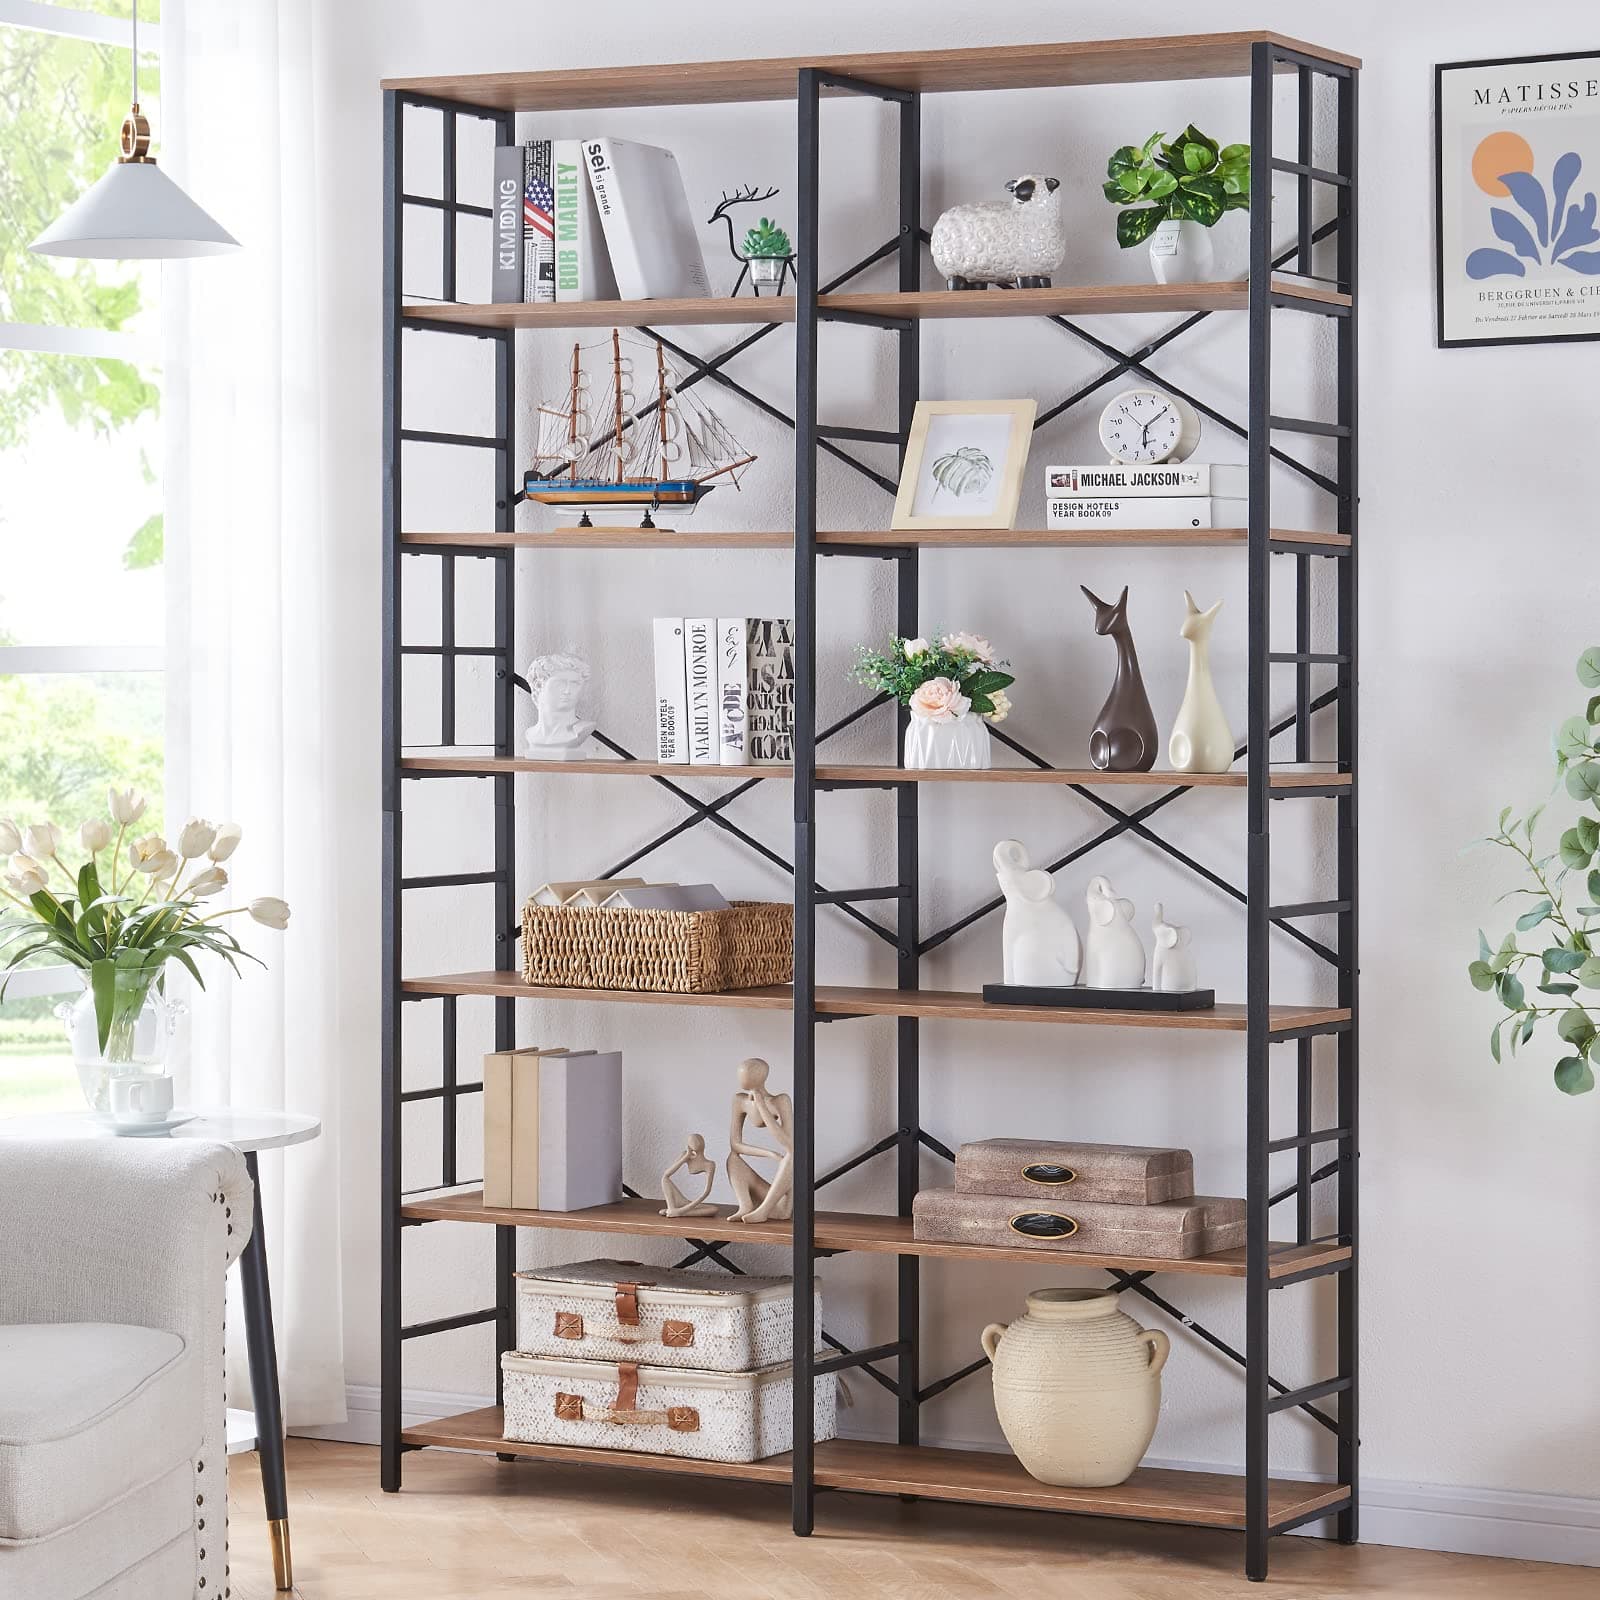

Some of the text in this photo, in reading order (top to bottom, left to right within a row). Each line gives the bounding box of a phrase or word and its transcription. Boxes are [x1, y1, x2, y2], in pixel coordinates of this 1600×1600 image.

[1473, 80, 1598, 105] MATISSE
[588, 144, 610, 173] sei
[557, 163, 578, 289] BOB MARLEY
[1479, 286, 1600, 301] BERGGRUEN & CIE
[1081, 472, 1180, 487] MICHAEL JACKSON
[1052, 510, 1075, 518] YEAR
[1087, 502, 1119, 510] HOTELS
[692, 624, 709, 759] MARILYN MONROE
[660, 699, 668, 759] DESIGN HOTELS
[667, 738, 675, 758] YEAR
